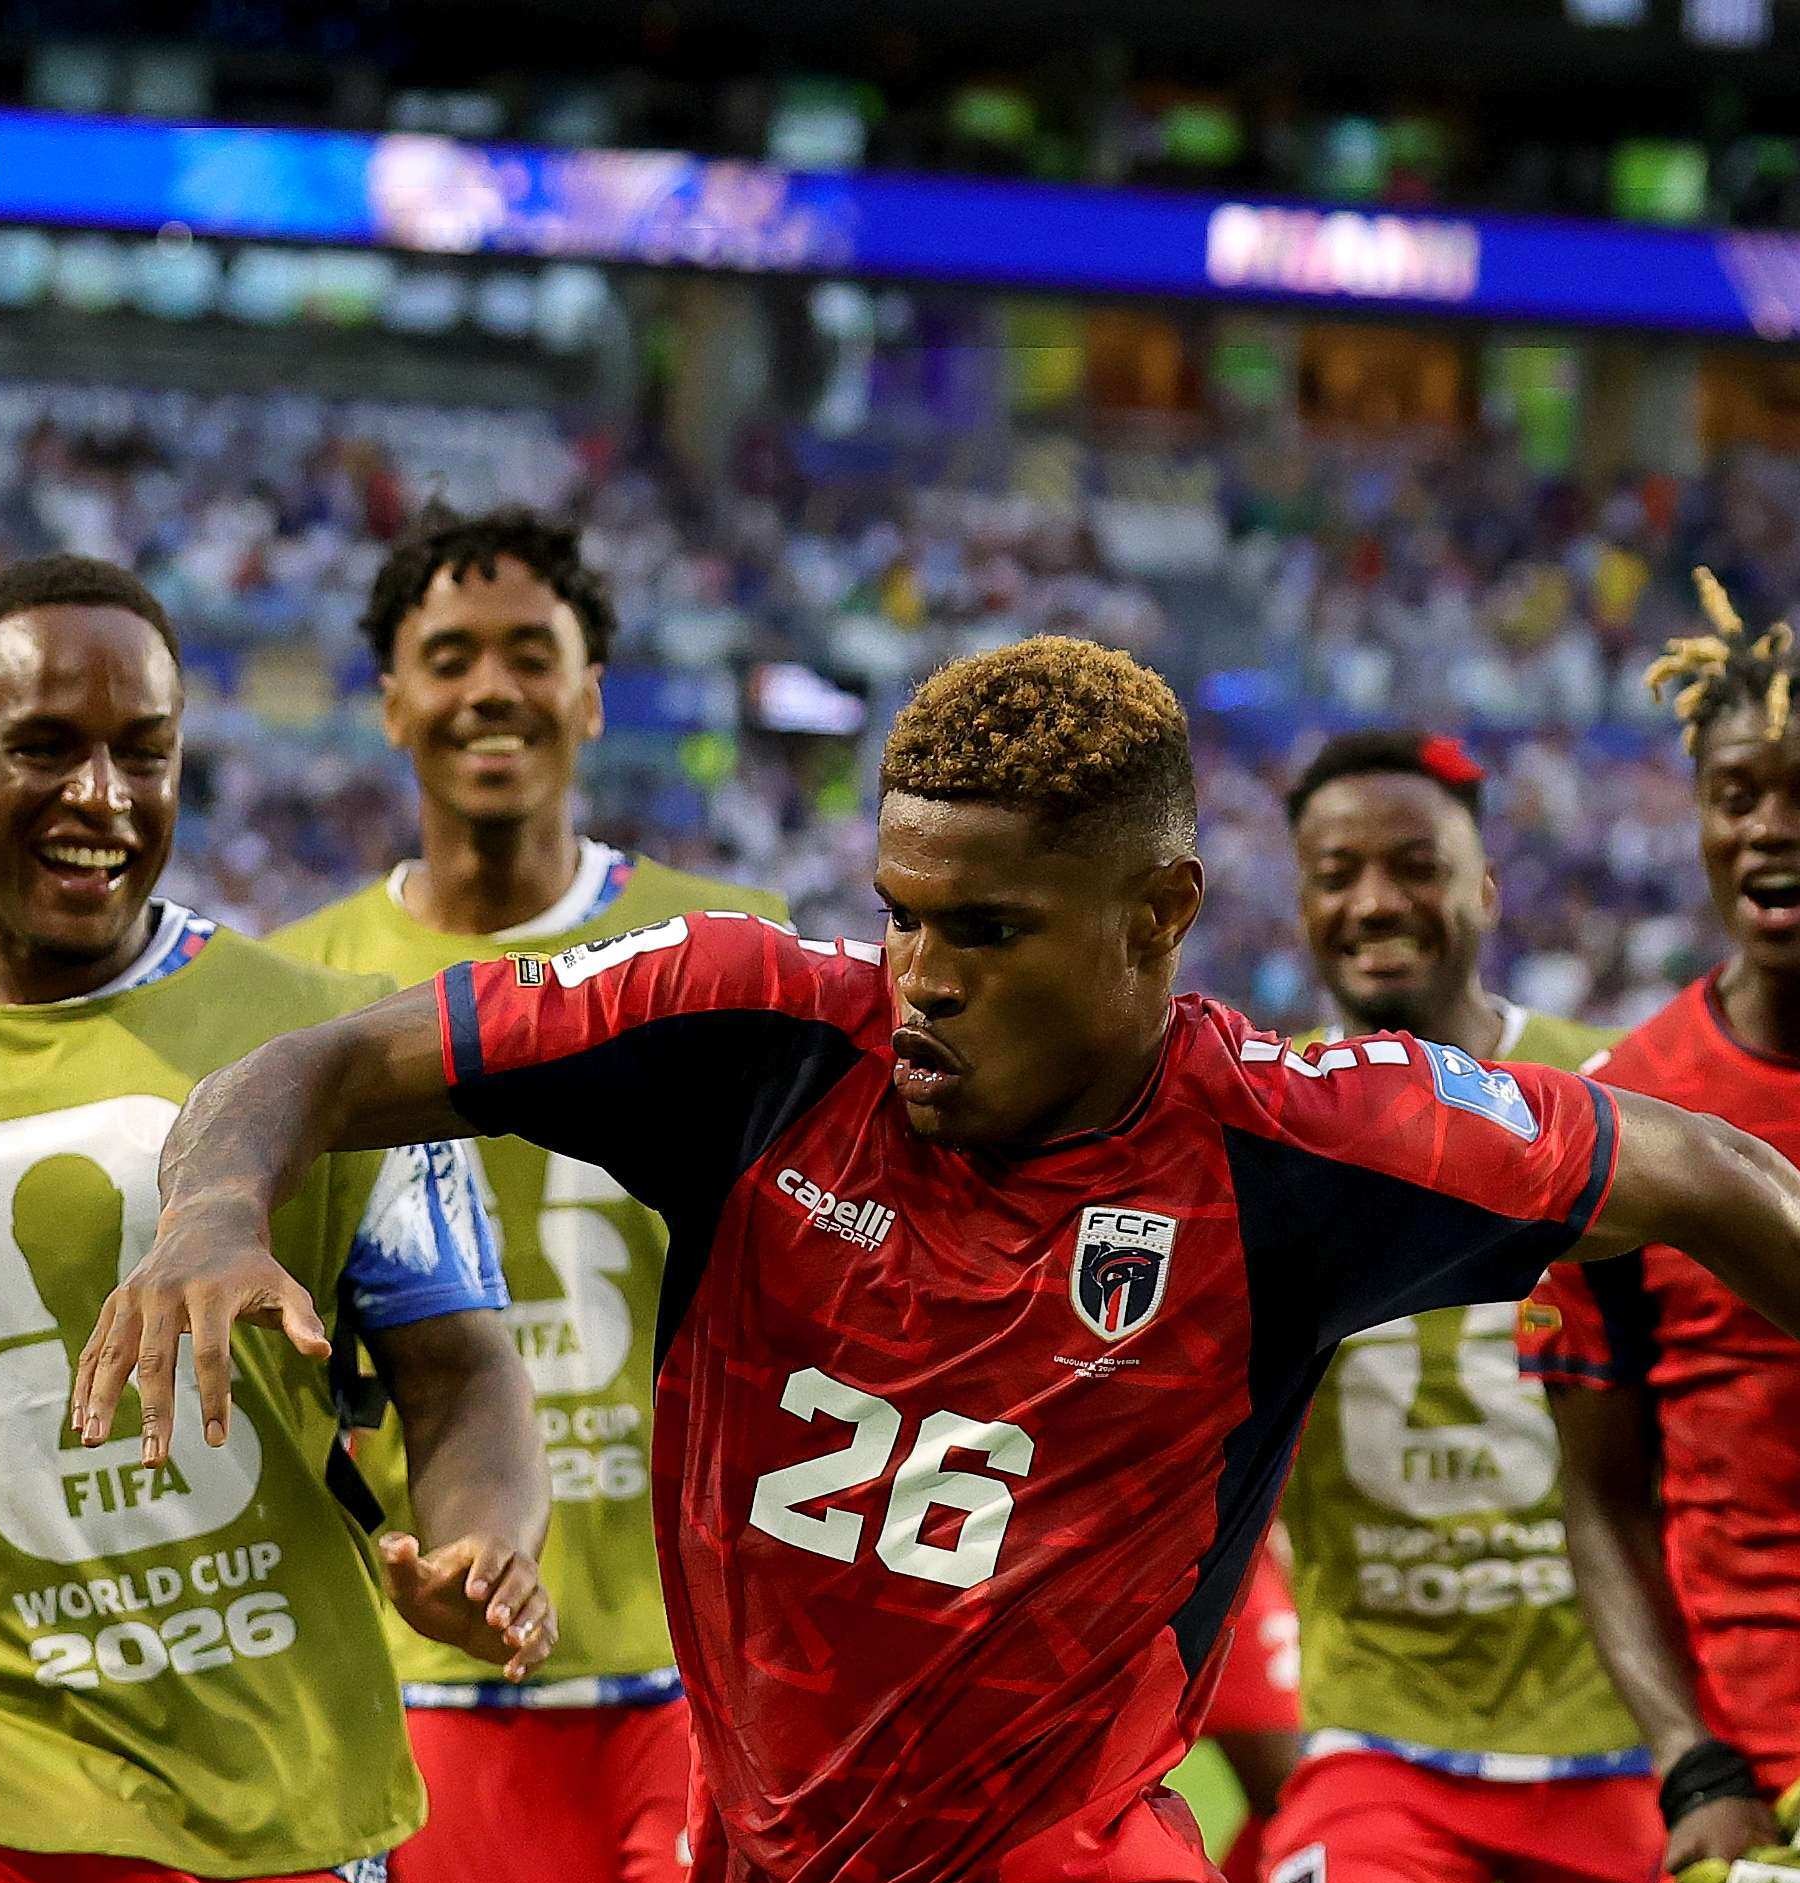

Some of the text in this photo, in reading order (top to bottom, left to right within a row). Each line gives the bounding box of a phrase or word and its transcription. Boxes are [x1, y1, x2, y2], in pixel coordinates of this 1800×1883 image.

[776, 1168, 896, 1242] capelli
[813, 1216, 880, 1252] SPORT
[1088, 1212, 1169, 1237] FCF
[513, 1318, 584, 1359] IFA
[62, 1458, 192, 1518] FIFA
[549, 1444, 648, 1499] 26
[749, 1367, 1036, 1588] 26
[12, 1541, 282, 1629] WORLD CUP
[31, 1591, 297, 1690] 2026
